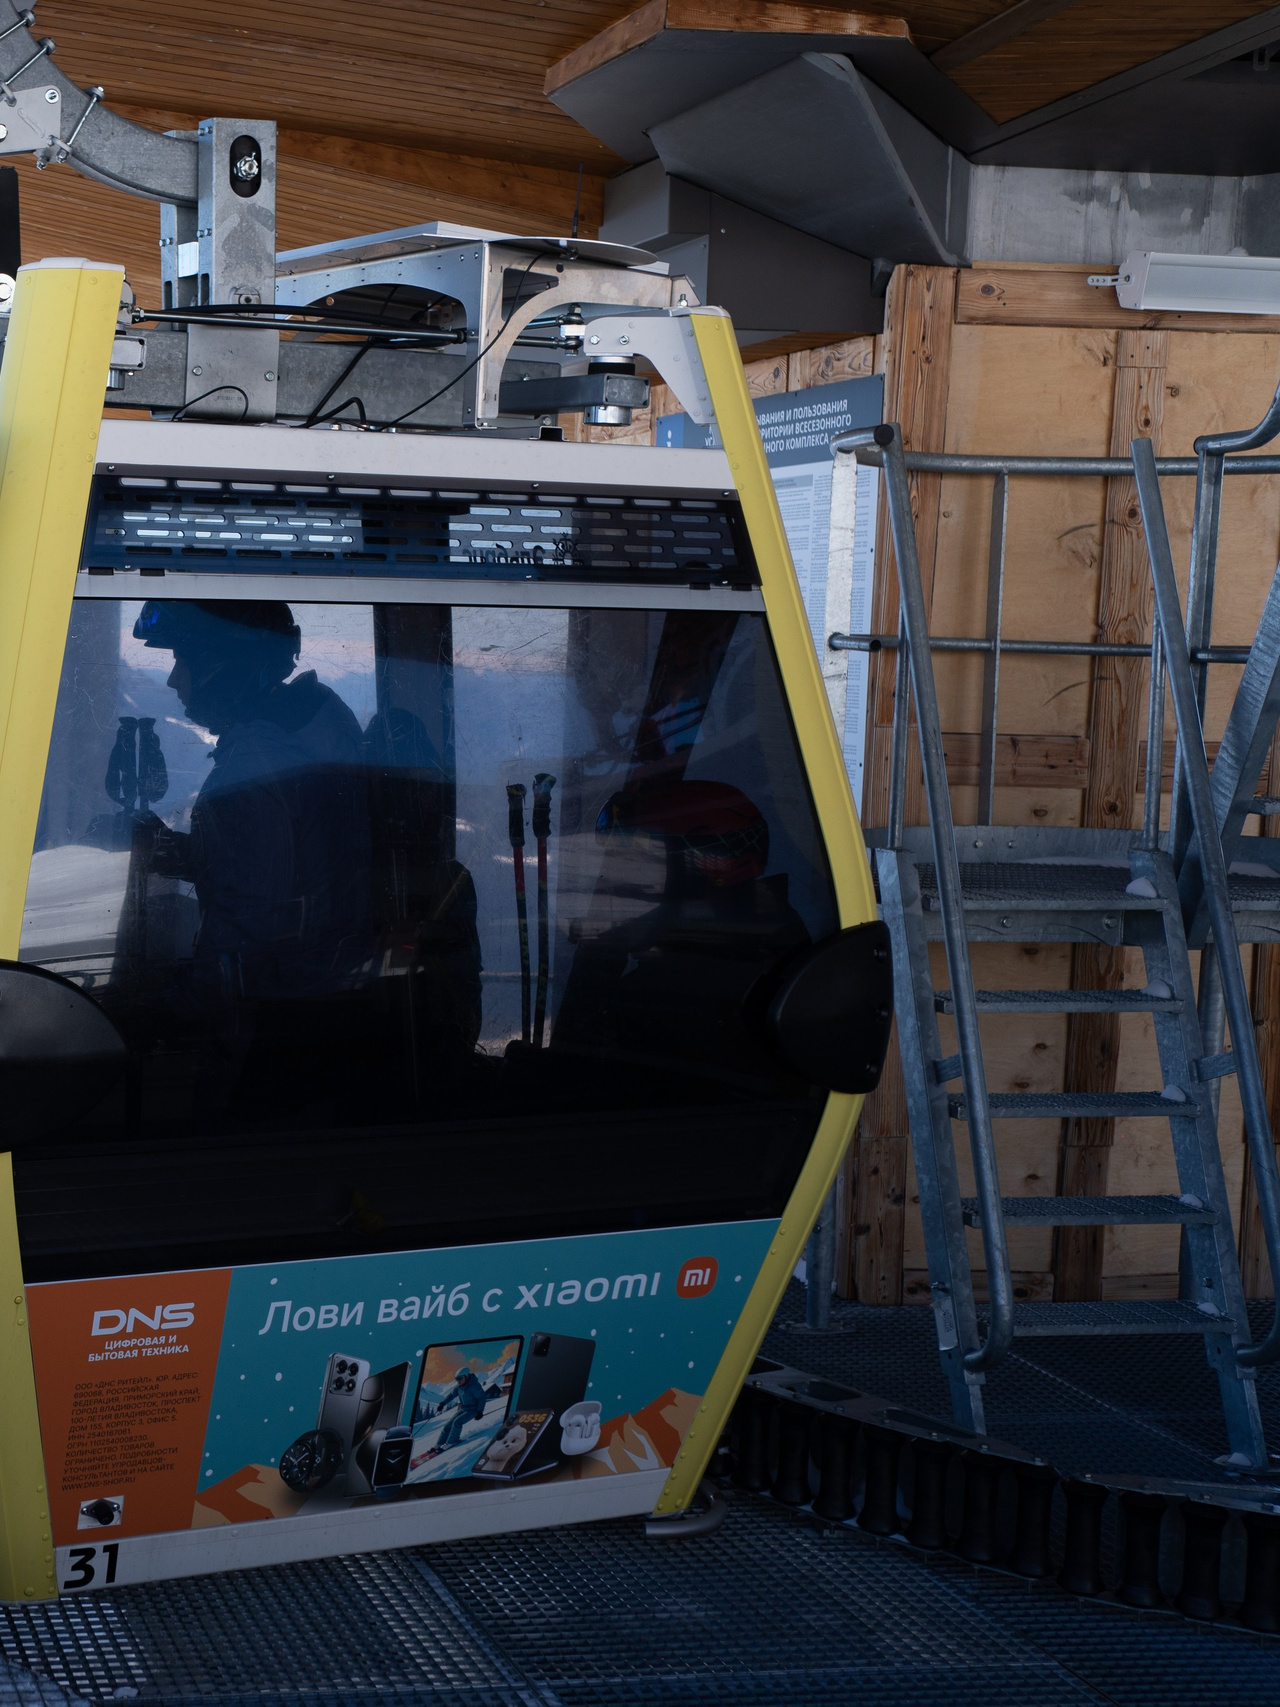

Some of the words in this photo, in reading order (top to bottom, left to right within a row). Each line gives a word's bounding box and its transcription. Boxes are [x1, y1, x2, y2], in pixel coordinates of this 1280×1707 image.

[786, 409, 792, 421] И
[793, 399, 848, 420] ПОЛЬЗОВАНИЯ
[795, 413, 852, 434] ВСЕСЕЗОННОГО
[764, 440, 785, 453] НОГО
[786, 432, 829, 450] КОМПЛЕКСА
[258, 1300, 364, 1335] Лови
[377, 1282, 471, 1323] вайб
[91, 1302, 195, 1336] DNS
[104, 1335, 166, 1350] ЦИФРОВАЯ
[168, 1334, 178, 1343] И
[88, 1349, 138, 1362] БЫТОВАЯ
[141, 1344, 190, 1357] ТЕХНИКА
[172, 1371, 200, 1381] АДРЕС:
[106, 1384, 160, 1396] РОССИЙСКАЯ
[123, 1389, 178, 1402] ПРИМОРСКИЙ
[72, 1407, 98, 1416] ГОРОД
[161, 1396, 201, 1407] ПРОСПЕКТ
[69, 1424, 88, 1433] ДОМ
[105, 1419, 137, 1429] КОРПУС
[147, 1415, 169, 1424] ОФИС
[71, 1414, 113, 1424] 100-ЛЕТИЯ
[66, 1441, 88, 1450] ОГРН
[68, 1433, 85, 1441] ИНН
[65, 1446, 118, 1458] КОЛИЧЕСТВО
[120, 1441, 155, 1451] ТОВАРОВ
[120, 1447, 178, 1460] ПОДРОБНОСТИ
[62, 1470, 128, 1483] КОНСУЛЬТАНТОВ
[150, 1463, 175, 1473] САЙТЕ
[63, 1463, 110, 1475] УТОЧНЯЙТЕ
[61, 1476, 135, 1491] WWW.DNS-SHOP.RU
[63, 1543, 119, 1590] 31
